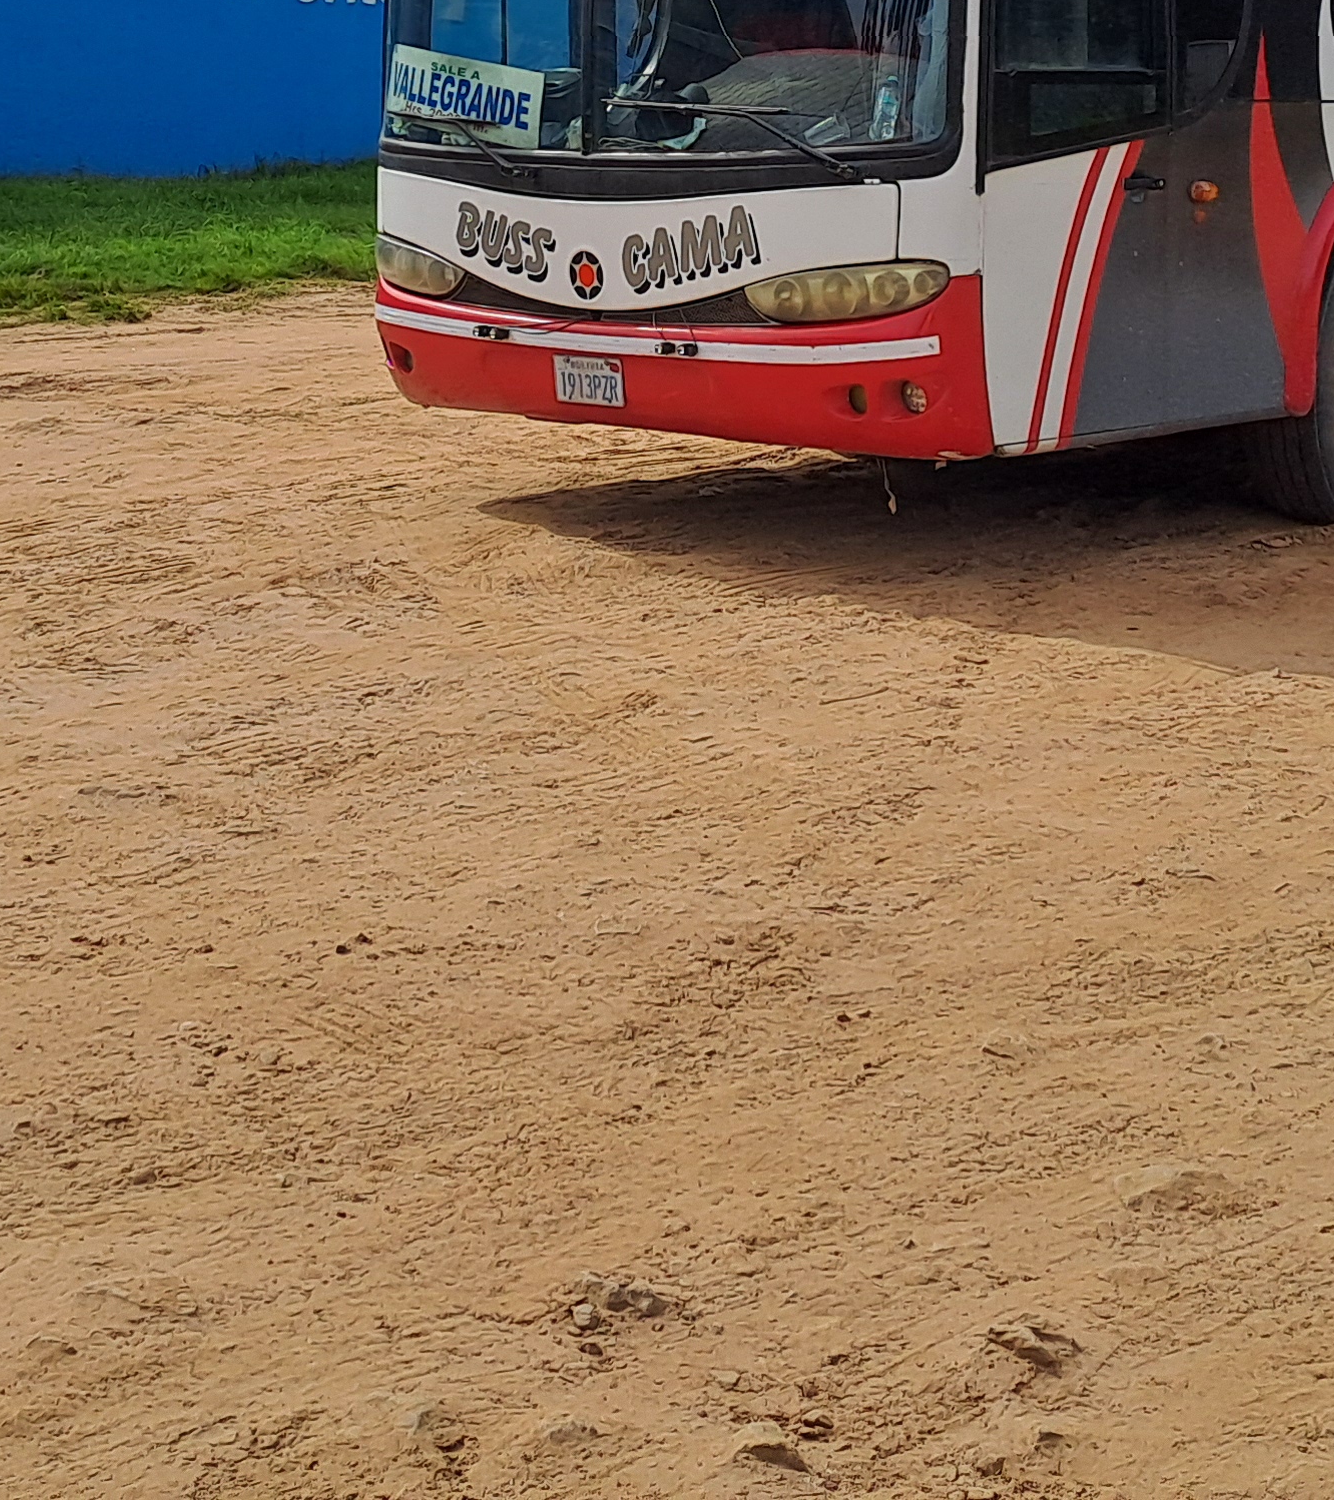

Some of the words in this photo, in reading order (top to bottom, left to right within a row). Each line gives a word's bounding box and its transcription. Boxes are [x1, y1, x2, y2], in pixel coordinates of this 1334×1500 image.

[394, 60, 531, 131] VALLEGRANDE
[431, 61, 467, 78] SALE
[470, 70, 481, 81] A
[456, 201, 556, 282] BUSS
[622, 205, 761, 294] CAMA
[561, 371, 619, 402] 1913PZR
